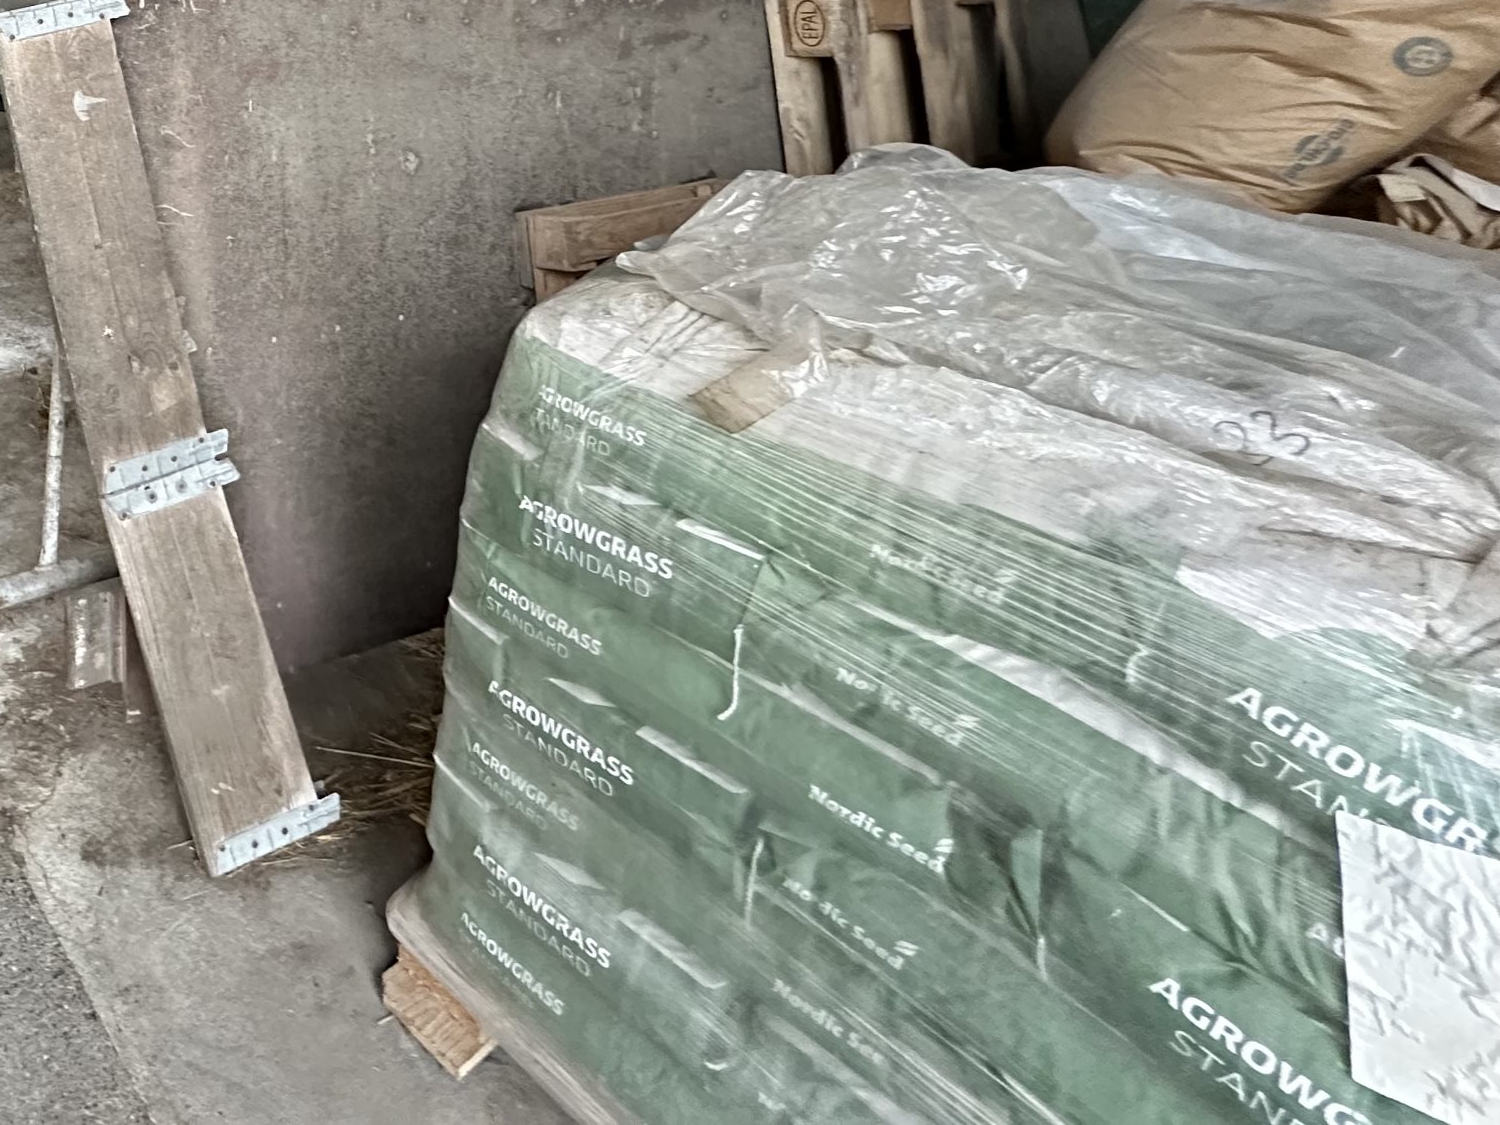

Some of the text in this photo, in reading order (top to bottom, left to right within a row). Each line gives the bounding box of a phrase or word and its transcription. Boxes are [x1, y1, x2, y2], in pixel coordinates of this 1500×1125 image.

[799, 10, 820, 41] EPAL
[531, 407, 611, 457] TANDARD
[519, 494, 674, 579] AGROWGRASS
[532, 528, 652, 598] STANDARD
[486, 595, 569, 659] STANDARD
[488, 576, 603, 656] AGROWGRASS
[488, 680, 634, 786] AGROWGRASS
[502, 713, 614, 797] STANDARD
[472, 742, 580, 831] AGROWGRASS
[808, 783, 947, 874] Nordic Seed
[473, 845, 612, 969] AGROWGRASS
[486, 878, 591, 978] STANDARD
[460, 912, 565, 1016] AGROWGRASS
[1169, 1030, 1309, 1125] STAN
